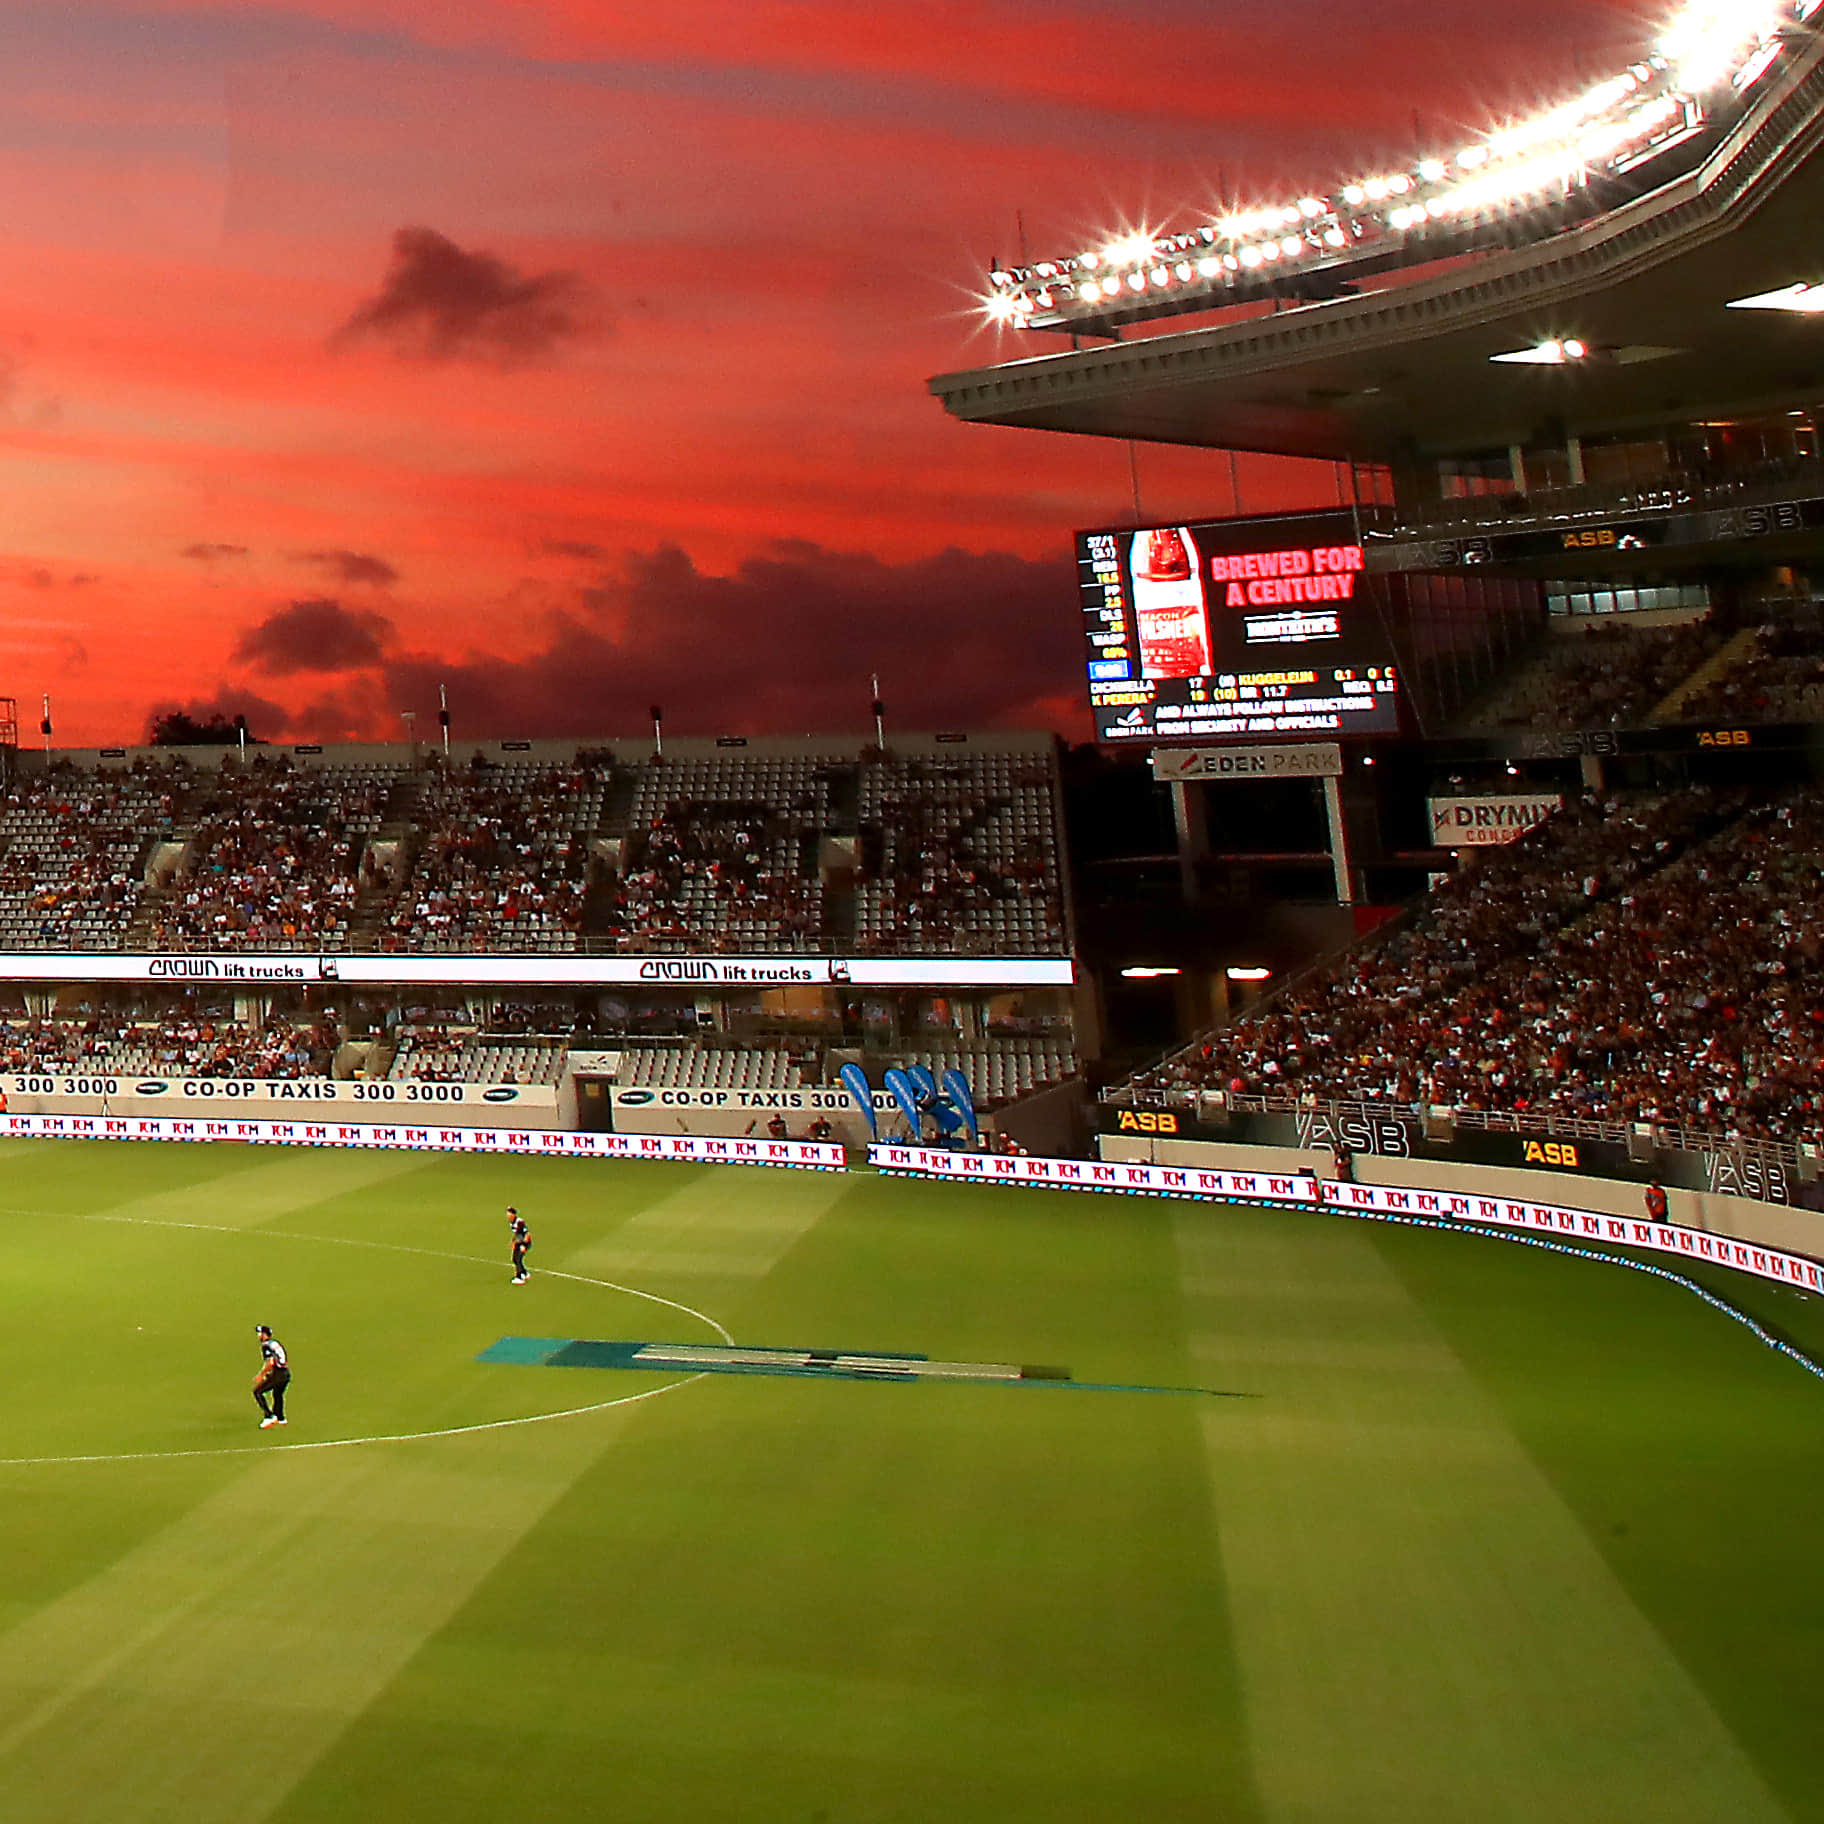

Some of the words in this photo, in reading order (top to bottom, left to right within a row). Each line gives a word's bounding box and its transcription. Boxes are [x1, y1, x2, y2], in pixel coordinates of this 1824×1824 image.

[1211, 550, 1312, 582] BREWED
[1312, 544, 1365, 574] FOR
[1225, 582, 1248, 607] A
[1247, 572, 1355, 606] CENTURY
[1188, 676, 1204, 689] 17
[1262, 685, 1289, 698] 11.7
[1091, 694, 1102, 707] K
[1213, 687, 1238, 702] (10)
[1698, 732, 1749, 746] ASB
[1203, 754, 1266, 773] EDEN
[1273, 752, 1337, 771] PARK
[224, 963, 246, 978] lift
[249, 964, 304, 978] trucks
[723, 965, 747, 980] lift
[751, 966, 812, 980] trucks
[15, 1078, 53, 1093] 300
[63, 1079, 118, 1094] 3000
[183, 1081, 256, 1098] CO-OP
[266, 1083, 337, 1099] TAXIS
[352, 1084, 395, 1100] 300
[406, 1085, 464, 1101] 3000
[660, 1090, 728, 1106] CO-OP
[739, 1091, 803, 1108] TAXIS
[811, 1093, 850, 1109] 300
[1119, 1111, 1178, 1133] ASB
[72, 1119, 94, 1132] TCM
[405, 1129, 428, 1142] TCM
[704, 1141, 728, 1155] TCM
[1524, 1139, 1578, 1168] ASB
[1056, 1163, 1081, 1179] TCM
[1161, 1170, 1187, 1187] TCM
[1267, 1178, 1295, 1195] TCM
[1383, 1191, 1410, 1209] TCM
